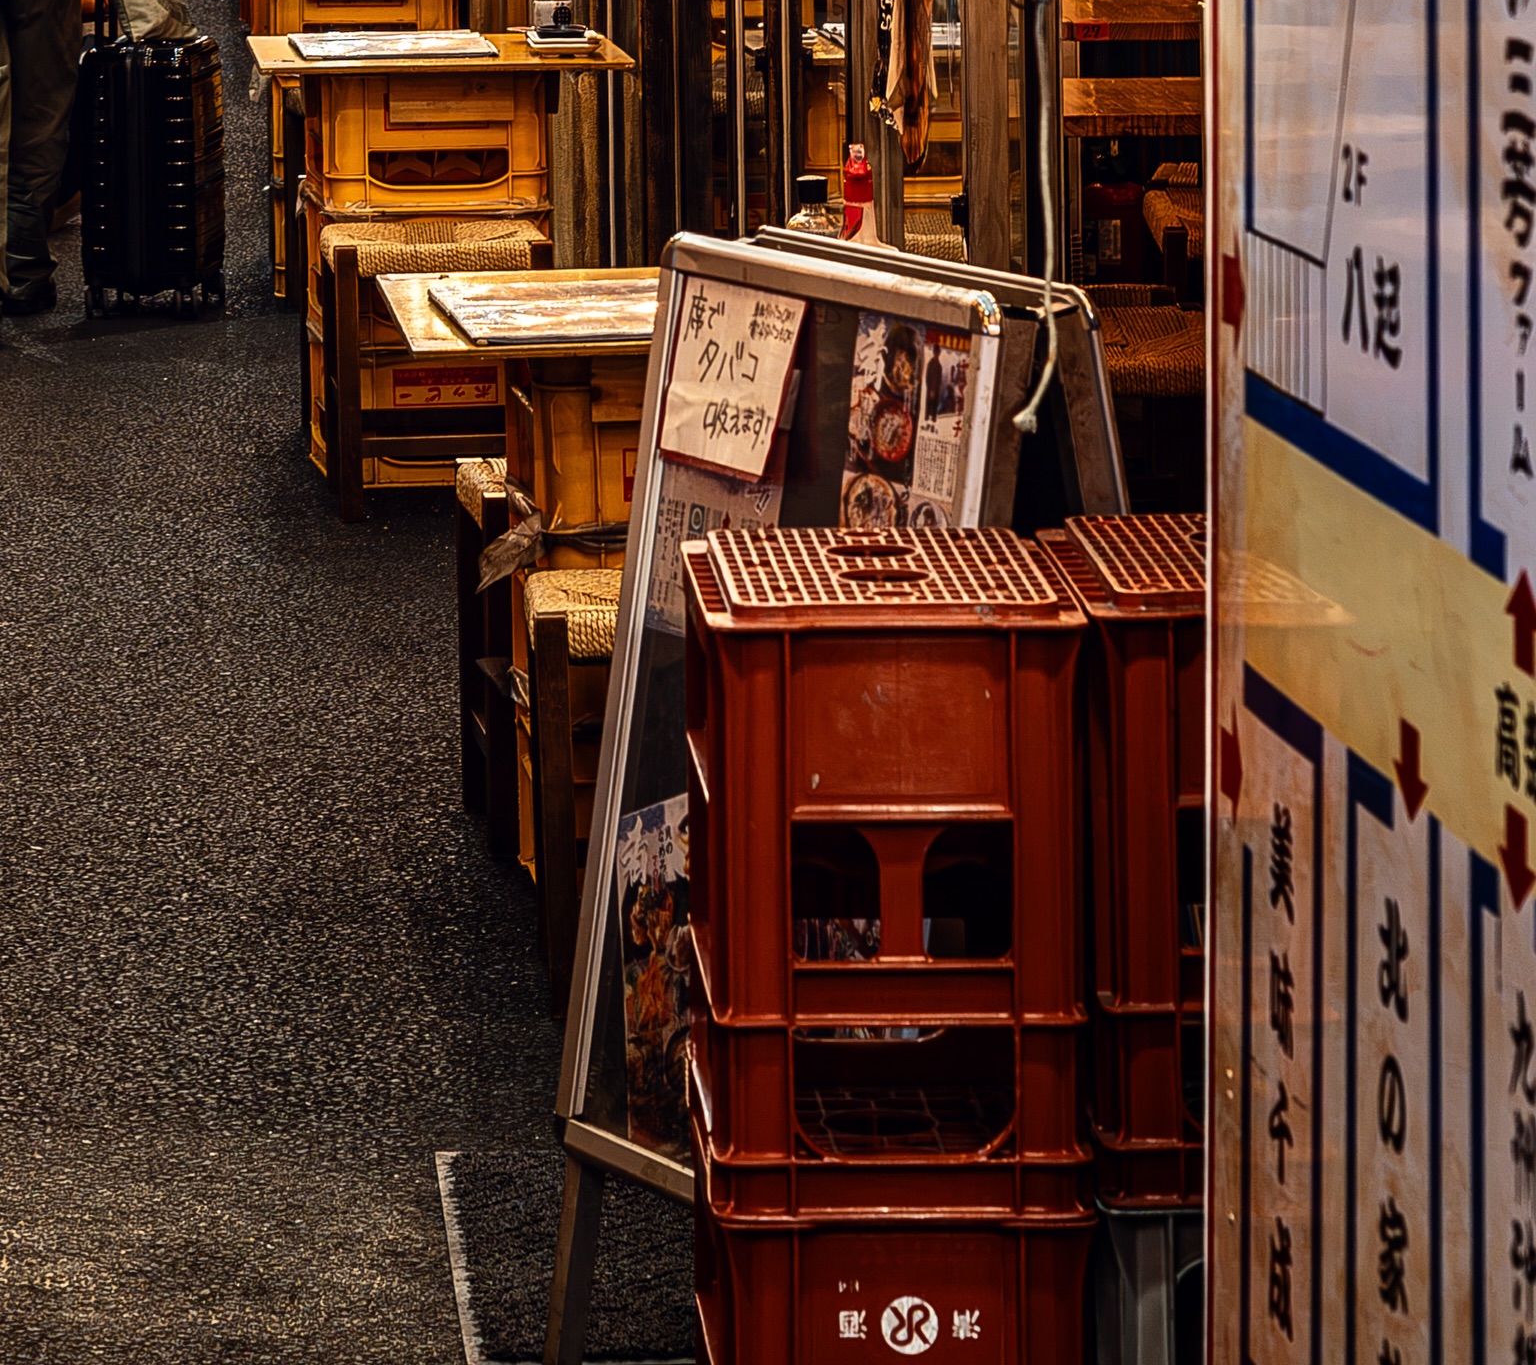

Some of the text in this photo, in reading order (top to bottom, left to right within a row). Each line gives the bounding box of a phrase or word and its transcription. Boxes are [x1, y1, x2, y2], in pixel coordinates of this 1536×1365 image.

[1341, 143, 1370, 206] 2F
[683, 283, 726, 342] 席で
[697, 338, 761, 383] タバコ
